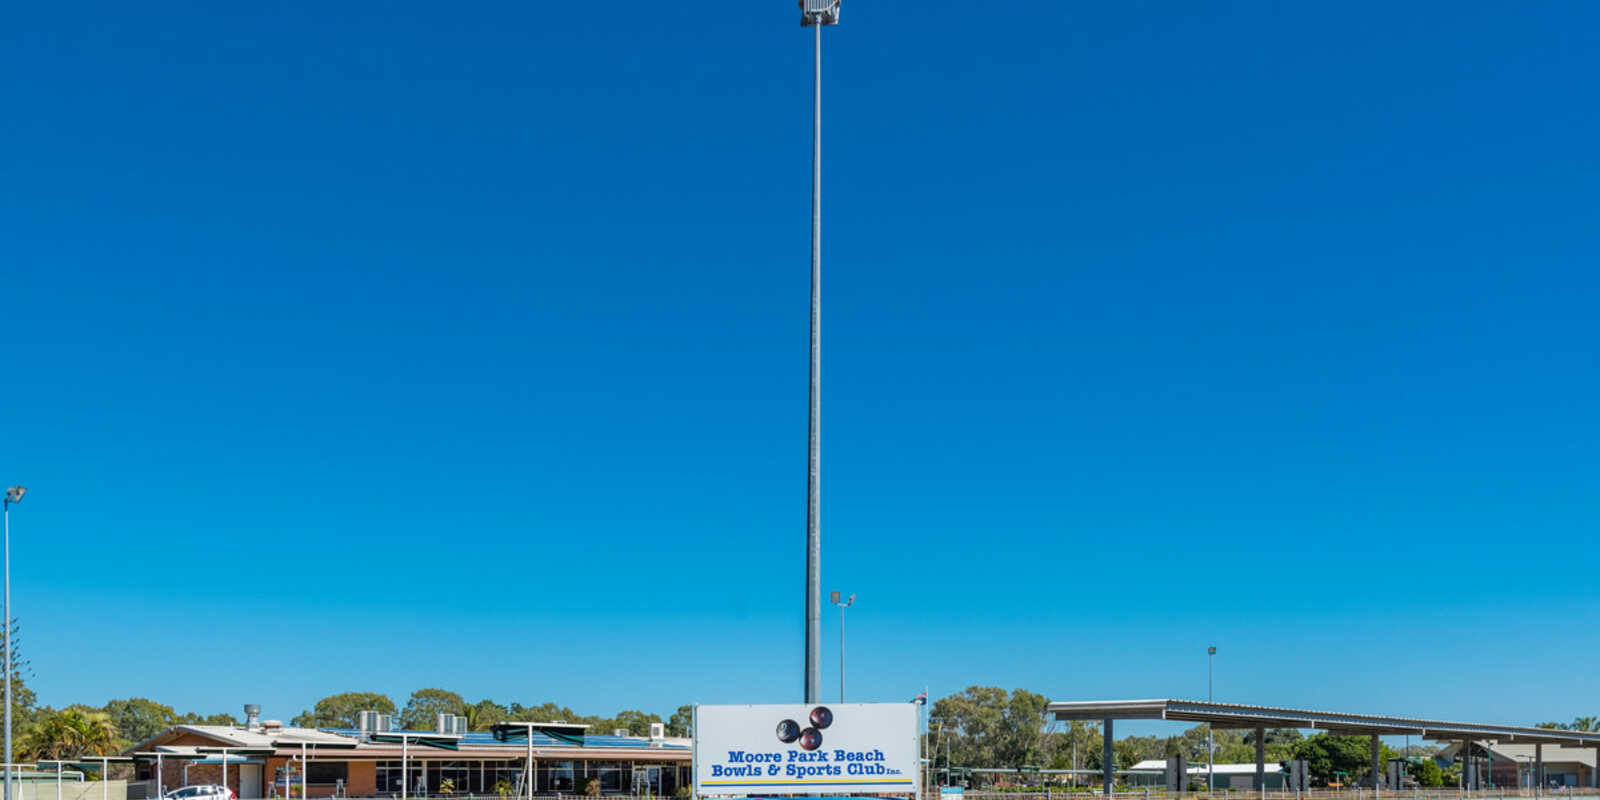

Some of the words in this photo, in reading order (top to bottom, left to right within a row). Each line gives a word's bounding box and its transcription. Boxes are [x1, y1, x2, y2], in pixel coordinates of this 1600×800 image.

[728, 750, 782, 763] Moore
[787, 749, 830, 762] Park
[833, 749, 886, 762] Beach
[711, 764, 762, 777] Bowls
[768, 764, 781, 776] &
[786, 763, 841, 779] Sports
[847, 762, 885, 775] Club
